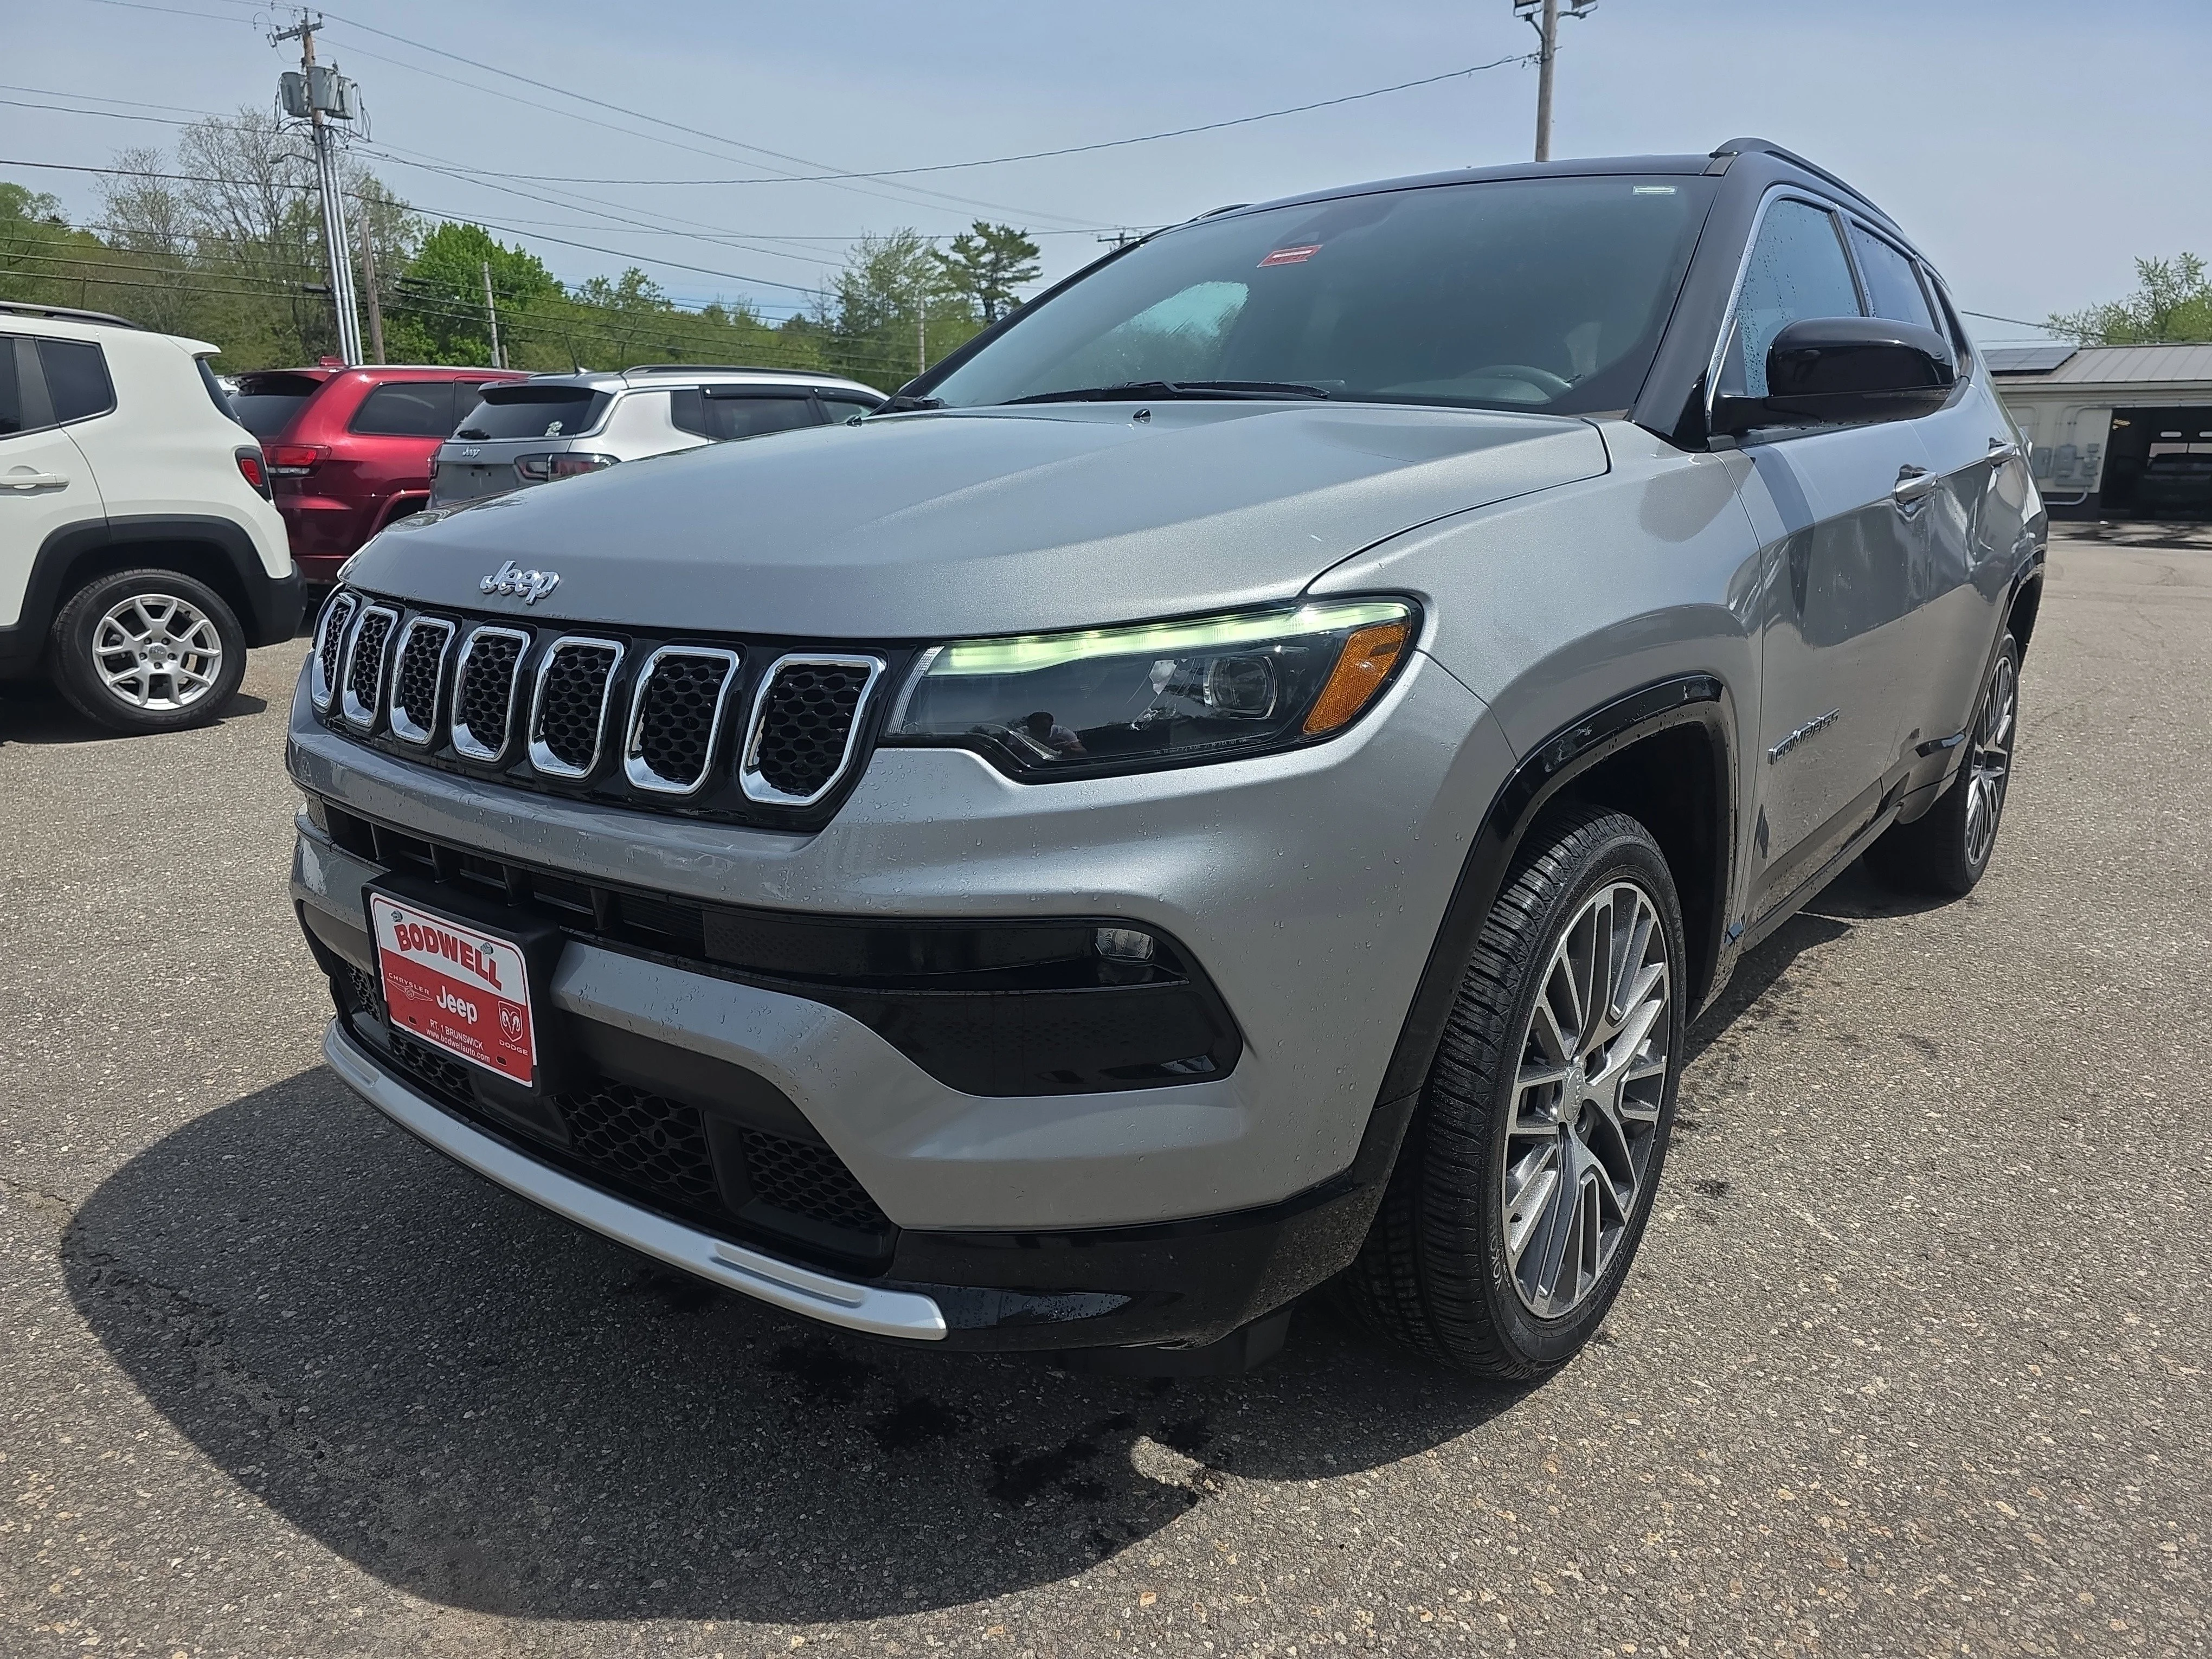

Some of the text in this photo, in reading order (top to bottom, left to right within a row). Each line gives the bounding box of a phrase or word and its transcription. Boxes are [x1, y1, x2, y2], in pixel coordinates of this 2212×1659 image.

[480, 560, 560, 605] Jeep
[394, 923, 503, 992] BODWELL
[388, 972, 429, 995] CHRYSLER
[436, 985, 478, 1025] Jeep
[426, 1028, 490, 1063] www.bodwellauto.com
[429, 1019, 484, 1051] RT. 1 BRUNSWICK
[499, 1039, 529, 1056] DODGE
